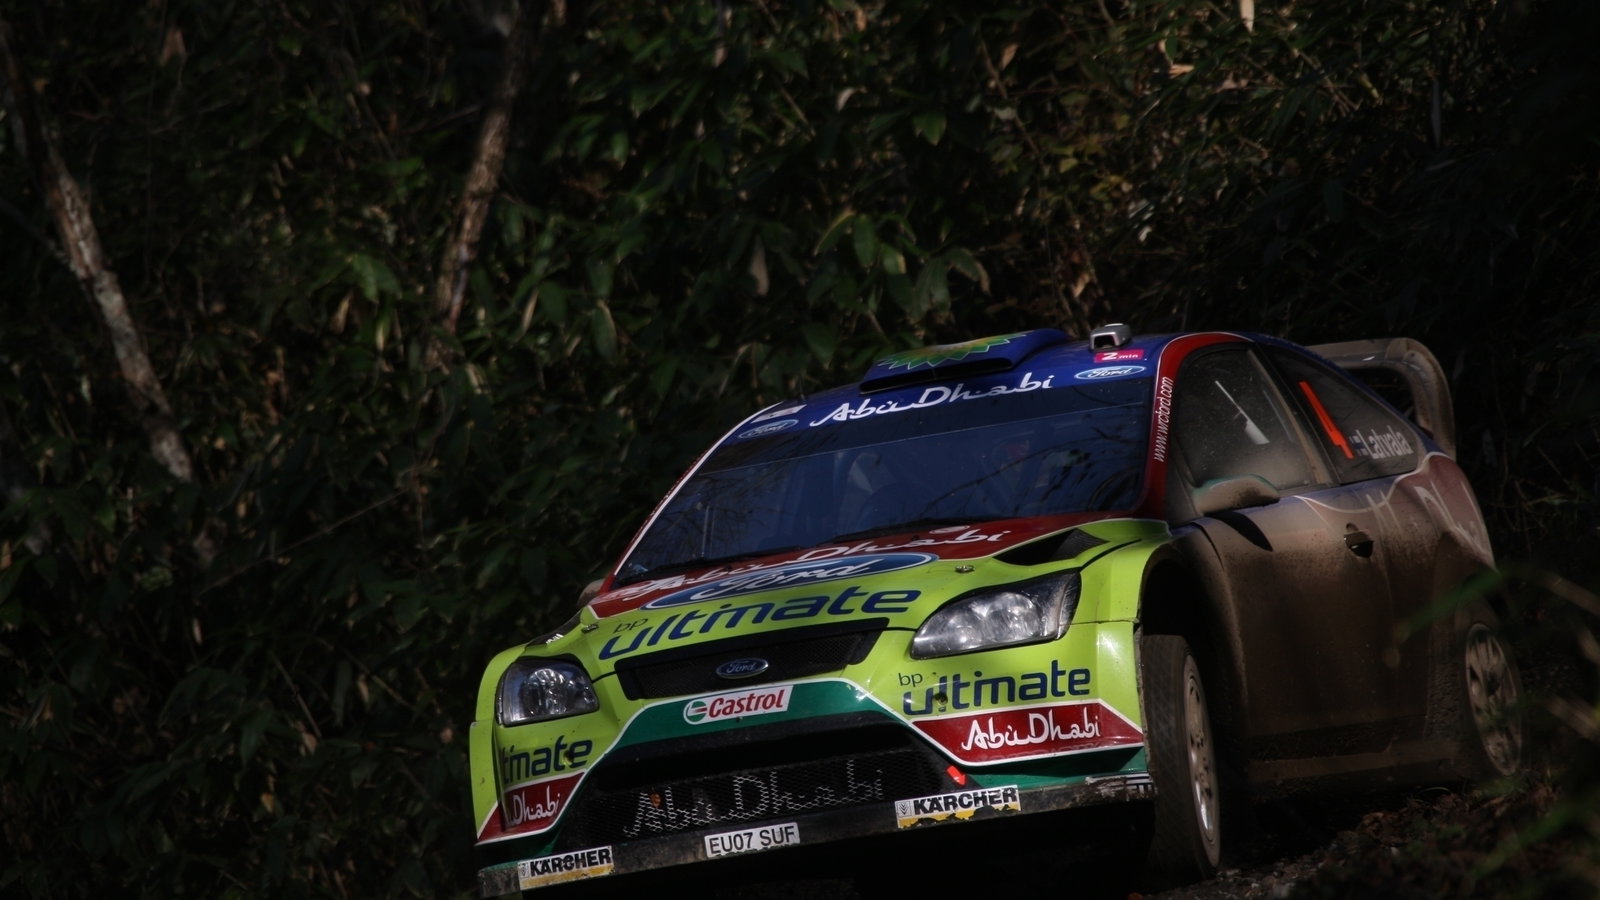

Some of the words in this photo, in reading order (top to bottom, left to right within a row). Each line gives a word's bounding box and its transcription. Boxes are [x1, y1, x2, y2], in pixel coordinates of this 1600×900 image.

[1086, 366, 1133, 378] Ford
[1153, 376, 1176, 463] www.wrcford.com
[1297, 379, 1355, 460] 4
[1355, 424, 1415, 460] Latvala
[689, 557, 886, 602] Ford
[599, 585, 921, 660] ultimate
[613, 617, 650, 634] bp
[724, 660, 759, 675] Ford
[898, 672, 923, 687] bp
[903, 659, 1091, 716] ultimate
[708, 689, 784, 719] Castrol
[913, 786, 1019, 816] KÄRCHER
[708, 831, 754, 856] EU07
[758, 825, 796, 848] SUF
[530, 847, 613, 877] KÄRCHER
